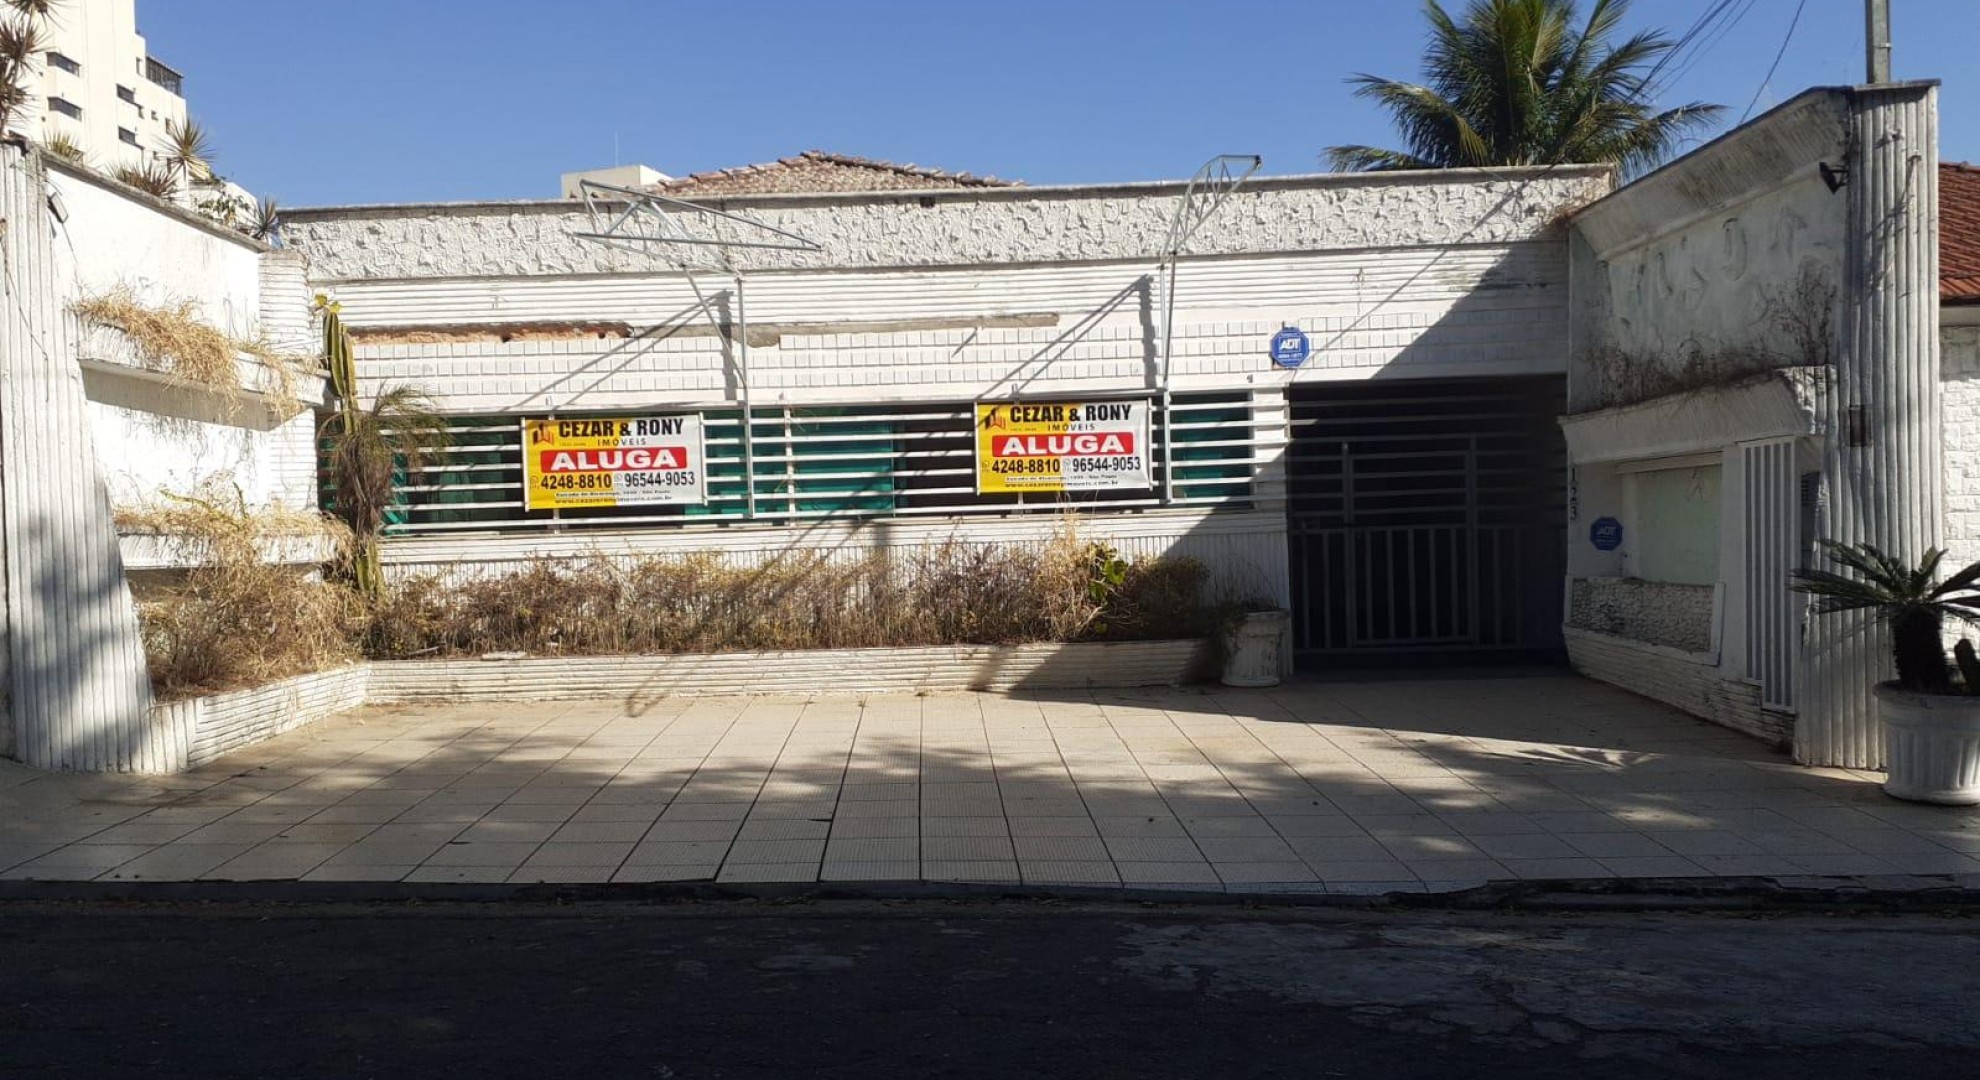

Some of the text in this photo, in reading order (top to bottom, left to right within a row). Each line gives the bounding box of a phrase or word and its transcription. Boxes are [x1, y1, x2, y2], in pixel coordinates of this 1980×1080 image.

[1279, 338, 1300, 350] ADT
[1010, 404, 1132, 423] CEZAR & RONY
[559, 418, 684, 438] CEZAR & RONY
[1001, 435, 1125, 456] ALUGA
[550, 449, 678, 471] ALUGA
[992, 457, 1141, 474] 4248-8810 96544-9053
[541, 471, 695, 490] 4248-8810 96544-9053
[1597, 526, 1616, 535] ADT
